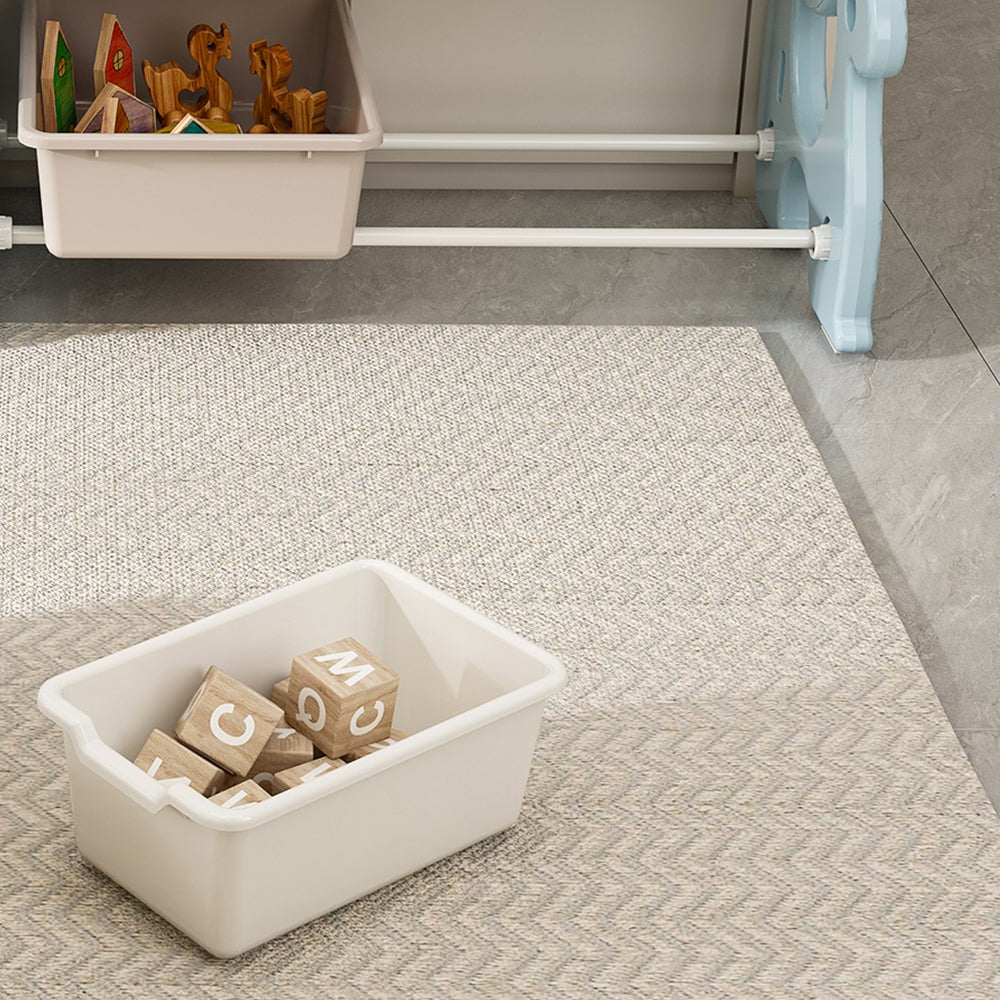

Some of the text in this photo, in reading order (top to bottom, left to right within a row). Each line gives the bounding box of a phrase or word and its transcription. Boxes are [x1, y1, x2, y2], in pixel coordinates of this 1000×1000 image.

[314, 650, 375, 687] M
[210, 703, 255, 747] C
[296, 687, 326, 732] Q
[349, 700, 385, 736] C
